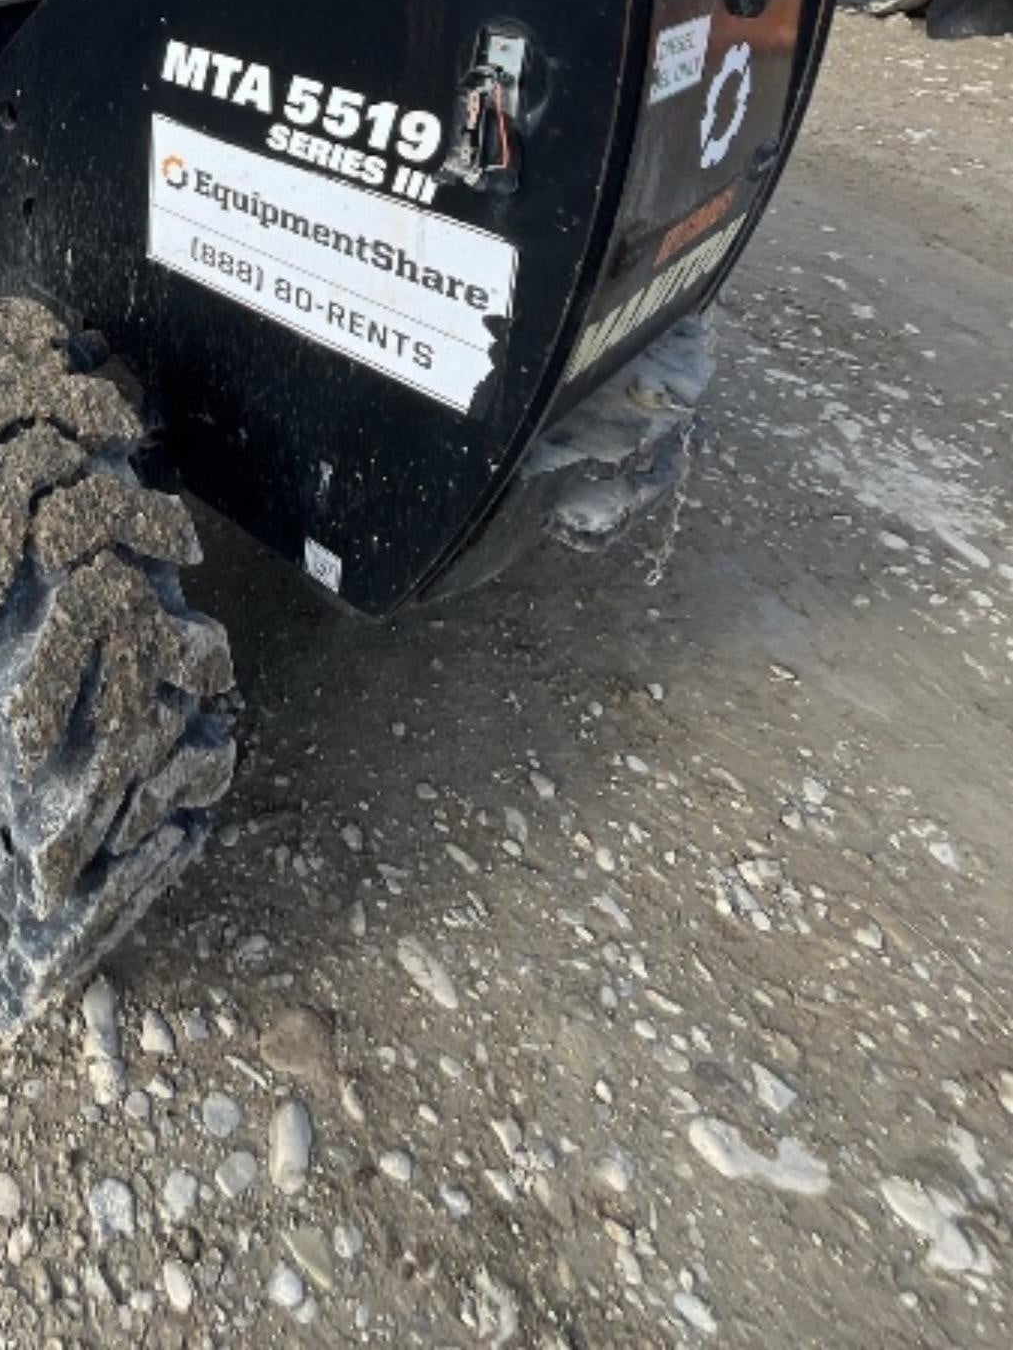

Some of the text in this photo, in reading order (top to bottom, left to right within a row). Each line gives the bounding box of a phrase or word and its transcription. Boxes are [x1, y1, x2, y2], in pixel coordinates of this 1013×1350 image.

[161, 39, 442, 163] MTA 5519
[265, 122, 439, 206] SERIES III
[190, 236, 435, 370] (888) 80-RENTS
[193, 167, 489, 311] EquipmentShare
